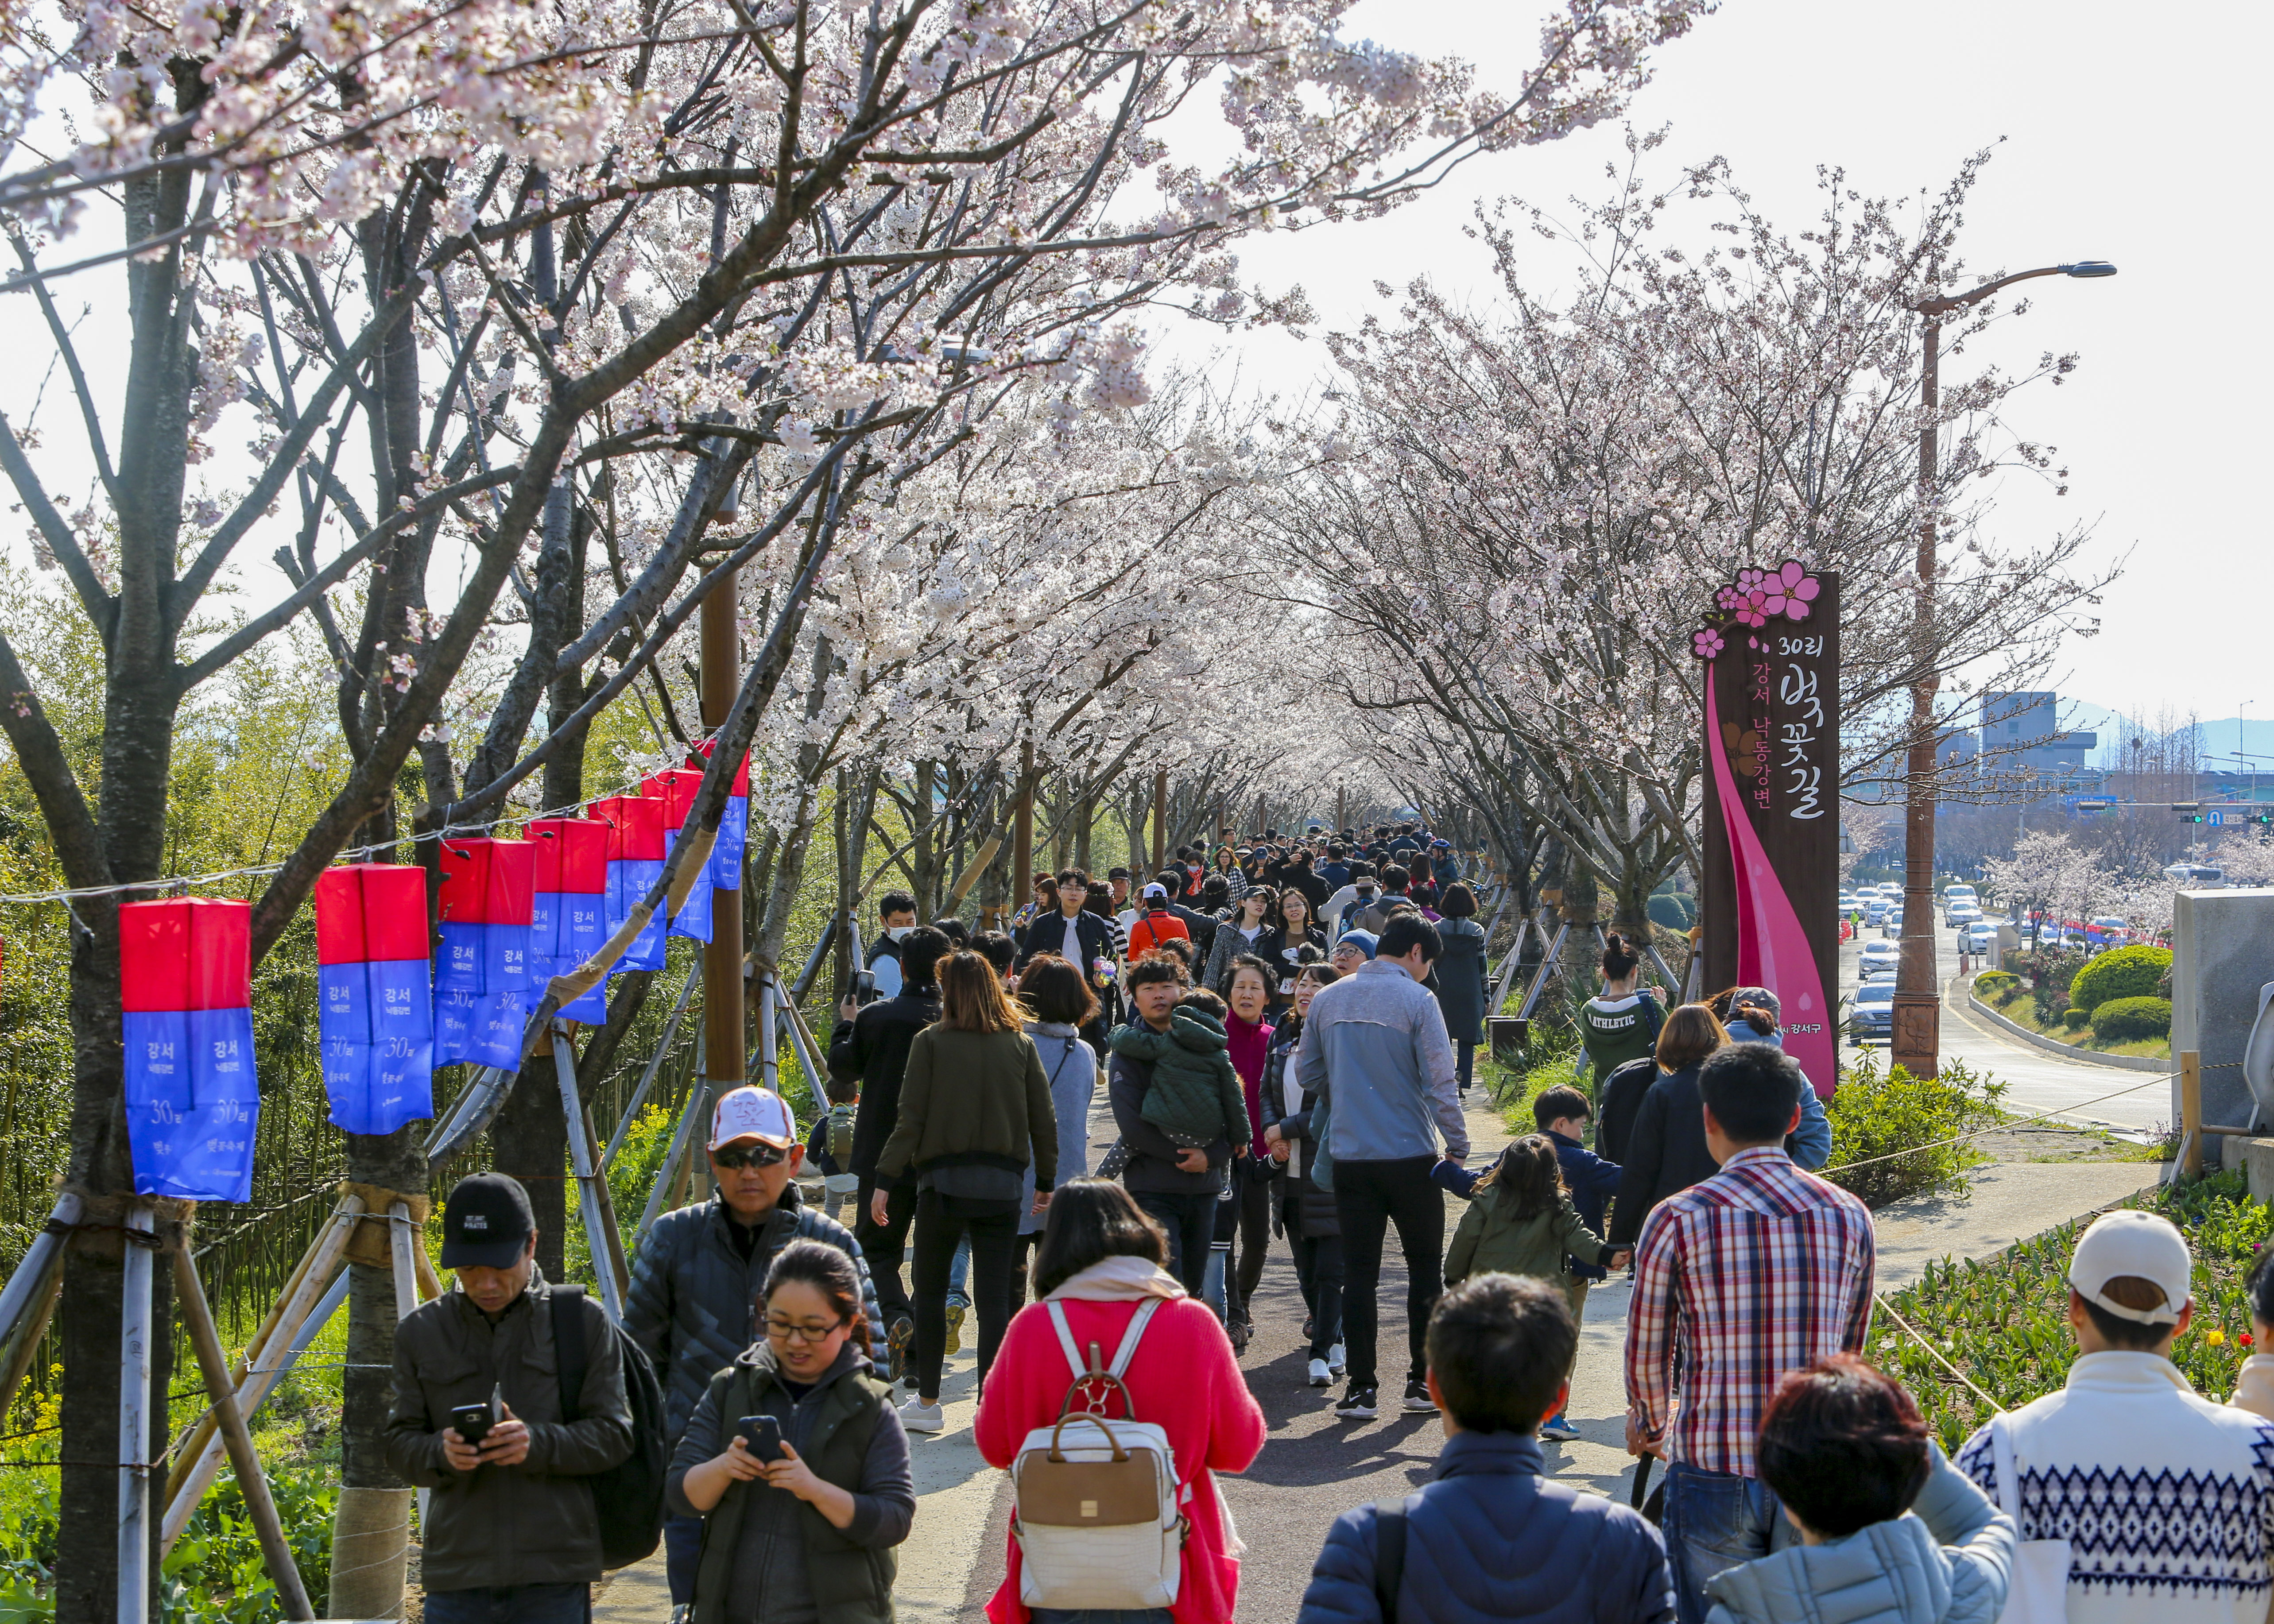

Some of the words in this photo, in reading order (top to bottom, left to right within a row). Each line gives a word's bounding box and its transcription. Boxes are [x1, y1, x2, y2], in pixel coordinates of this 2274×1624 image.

[1778, 634, 1824, 657] 30리
[1752, 662, 1771, 705] 강서
[1780, 663, 1825, 820] 벚꽃길
[1753, 717, 1772, 810] 낙동강변
[724, 810, 740, 819] 강서
[724, 837, 739, 852] 30리
[573, 910, 595, 923] 강서
[452, 946, 474, 960] 강서
[504, 949, 523, 963] 강서
[329, 986, 350, 1001] 강서
[384, 987, 411, 1003] 강서
[448, 988, 475, 1009] 30리
[496, 991, 520, 1011] 30리
[1592, 1014, 1635, 1029] ATHLETIC
[1790, 1023, 1821, 1035] 강서구
[147, 1042, 174, 1059] 강서
[213, 1040, 239, 1059] 강서
[329, 1035, 354, 1057] 30리
[384, 1036, 416, 1059] 30리
[151, 1099, 183, 1125] 30리
[213, 1098, 248, 1124] 30리
